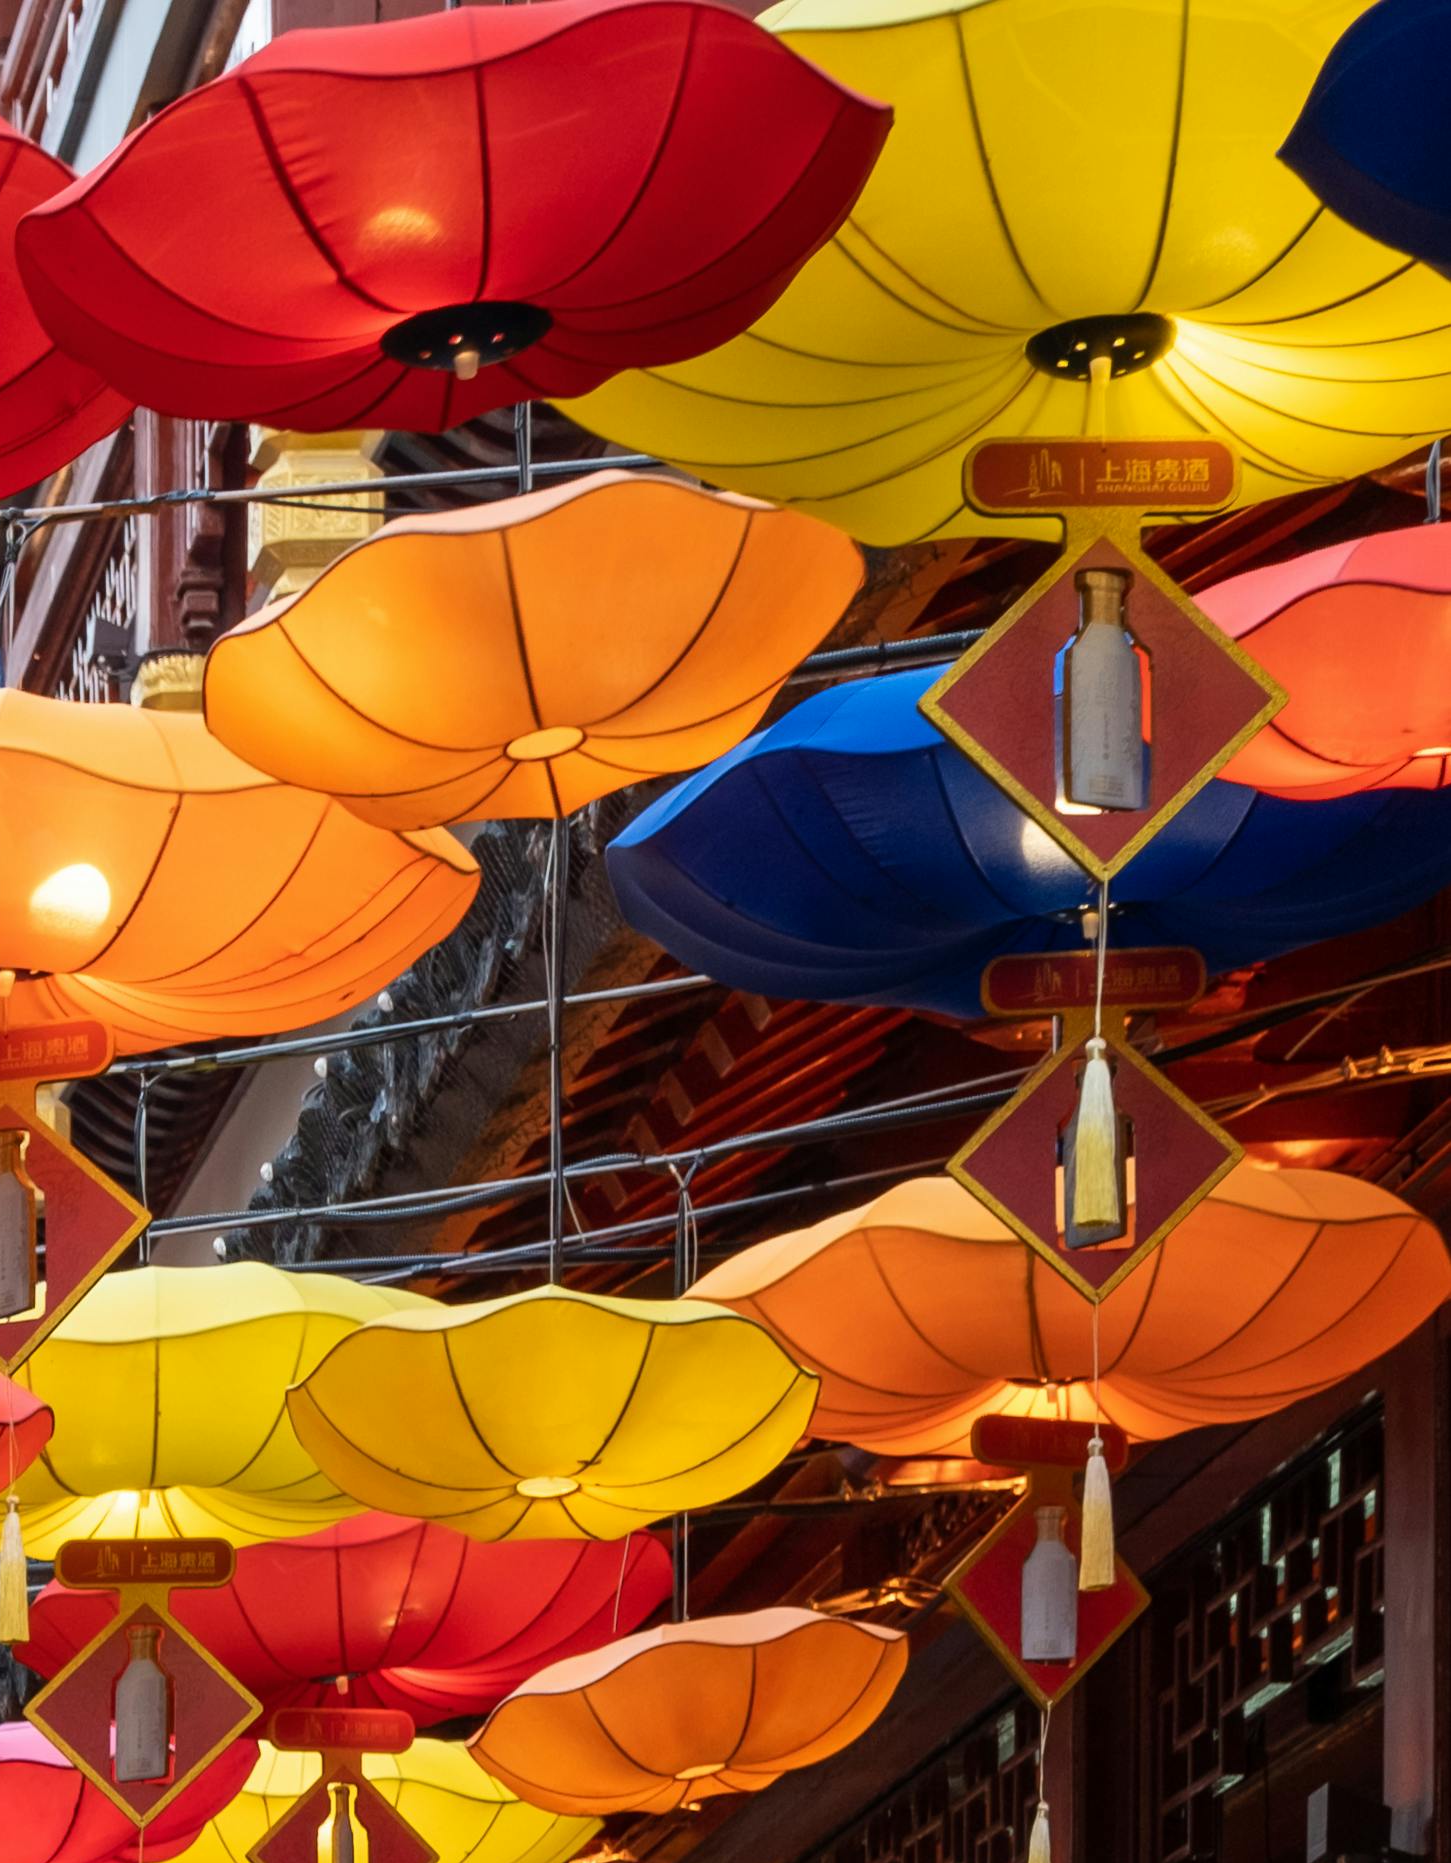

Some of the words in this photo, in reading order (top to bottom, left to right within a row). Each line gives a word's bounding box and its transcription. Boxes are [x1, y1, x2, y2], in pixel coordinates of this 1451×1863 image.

[1096, 457, 1210, 484] 上海贵酒
[0, 1034, 89, 1062] 上海贵酒
